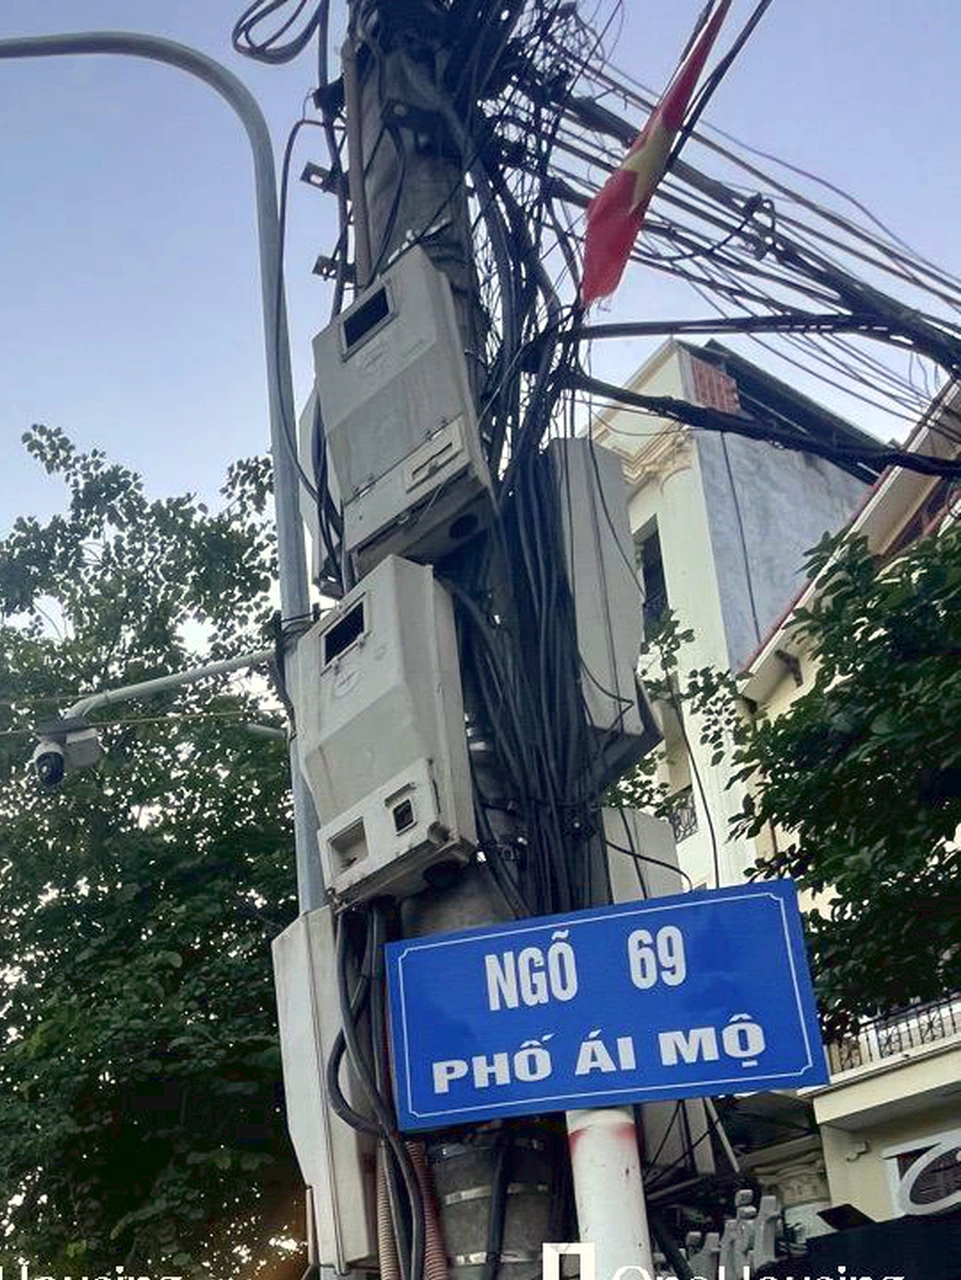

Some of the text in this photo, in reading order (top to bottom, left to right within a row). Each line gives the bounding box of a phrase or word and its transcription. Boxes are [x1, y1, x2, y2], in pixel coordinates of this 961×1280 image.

[485, 926, 687, 1011] NGÕ 69
[432, 1013, 767, 1095] PHỐ ÁI MỘ
